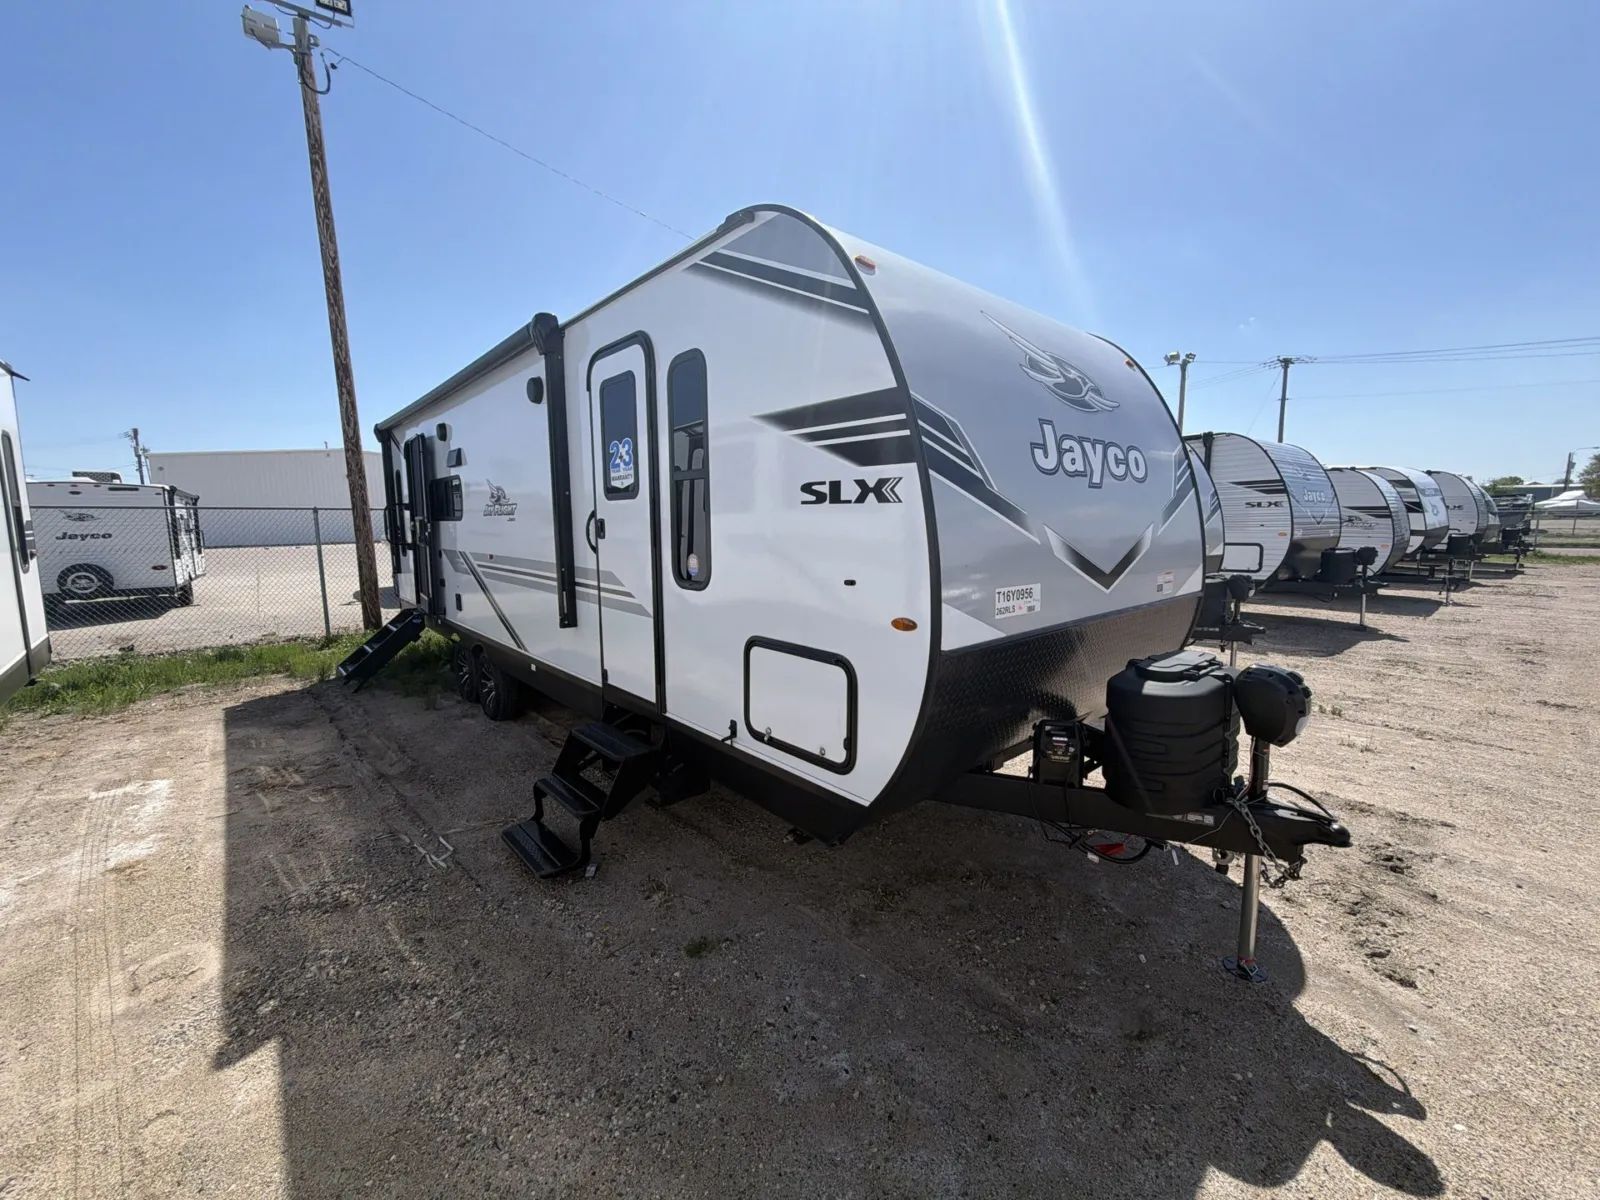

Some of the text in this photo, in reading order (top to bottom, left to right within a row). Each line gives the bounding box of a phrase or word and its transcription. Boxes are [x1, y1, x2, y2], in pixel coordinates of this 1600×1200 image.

[1030, 418, 1148, 489] Jayco
[800, 477, 904, 505] SLX
[55, 532, 113, 541] Jayco
[996, 587, 1034, 603] T16Y0956
